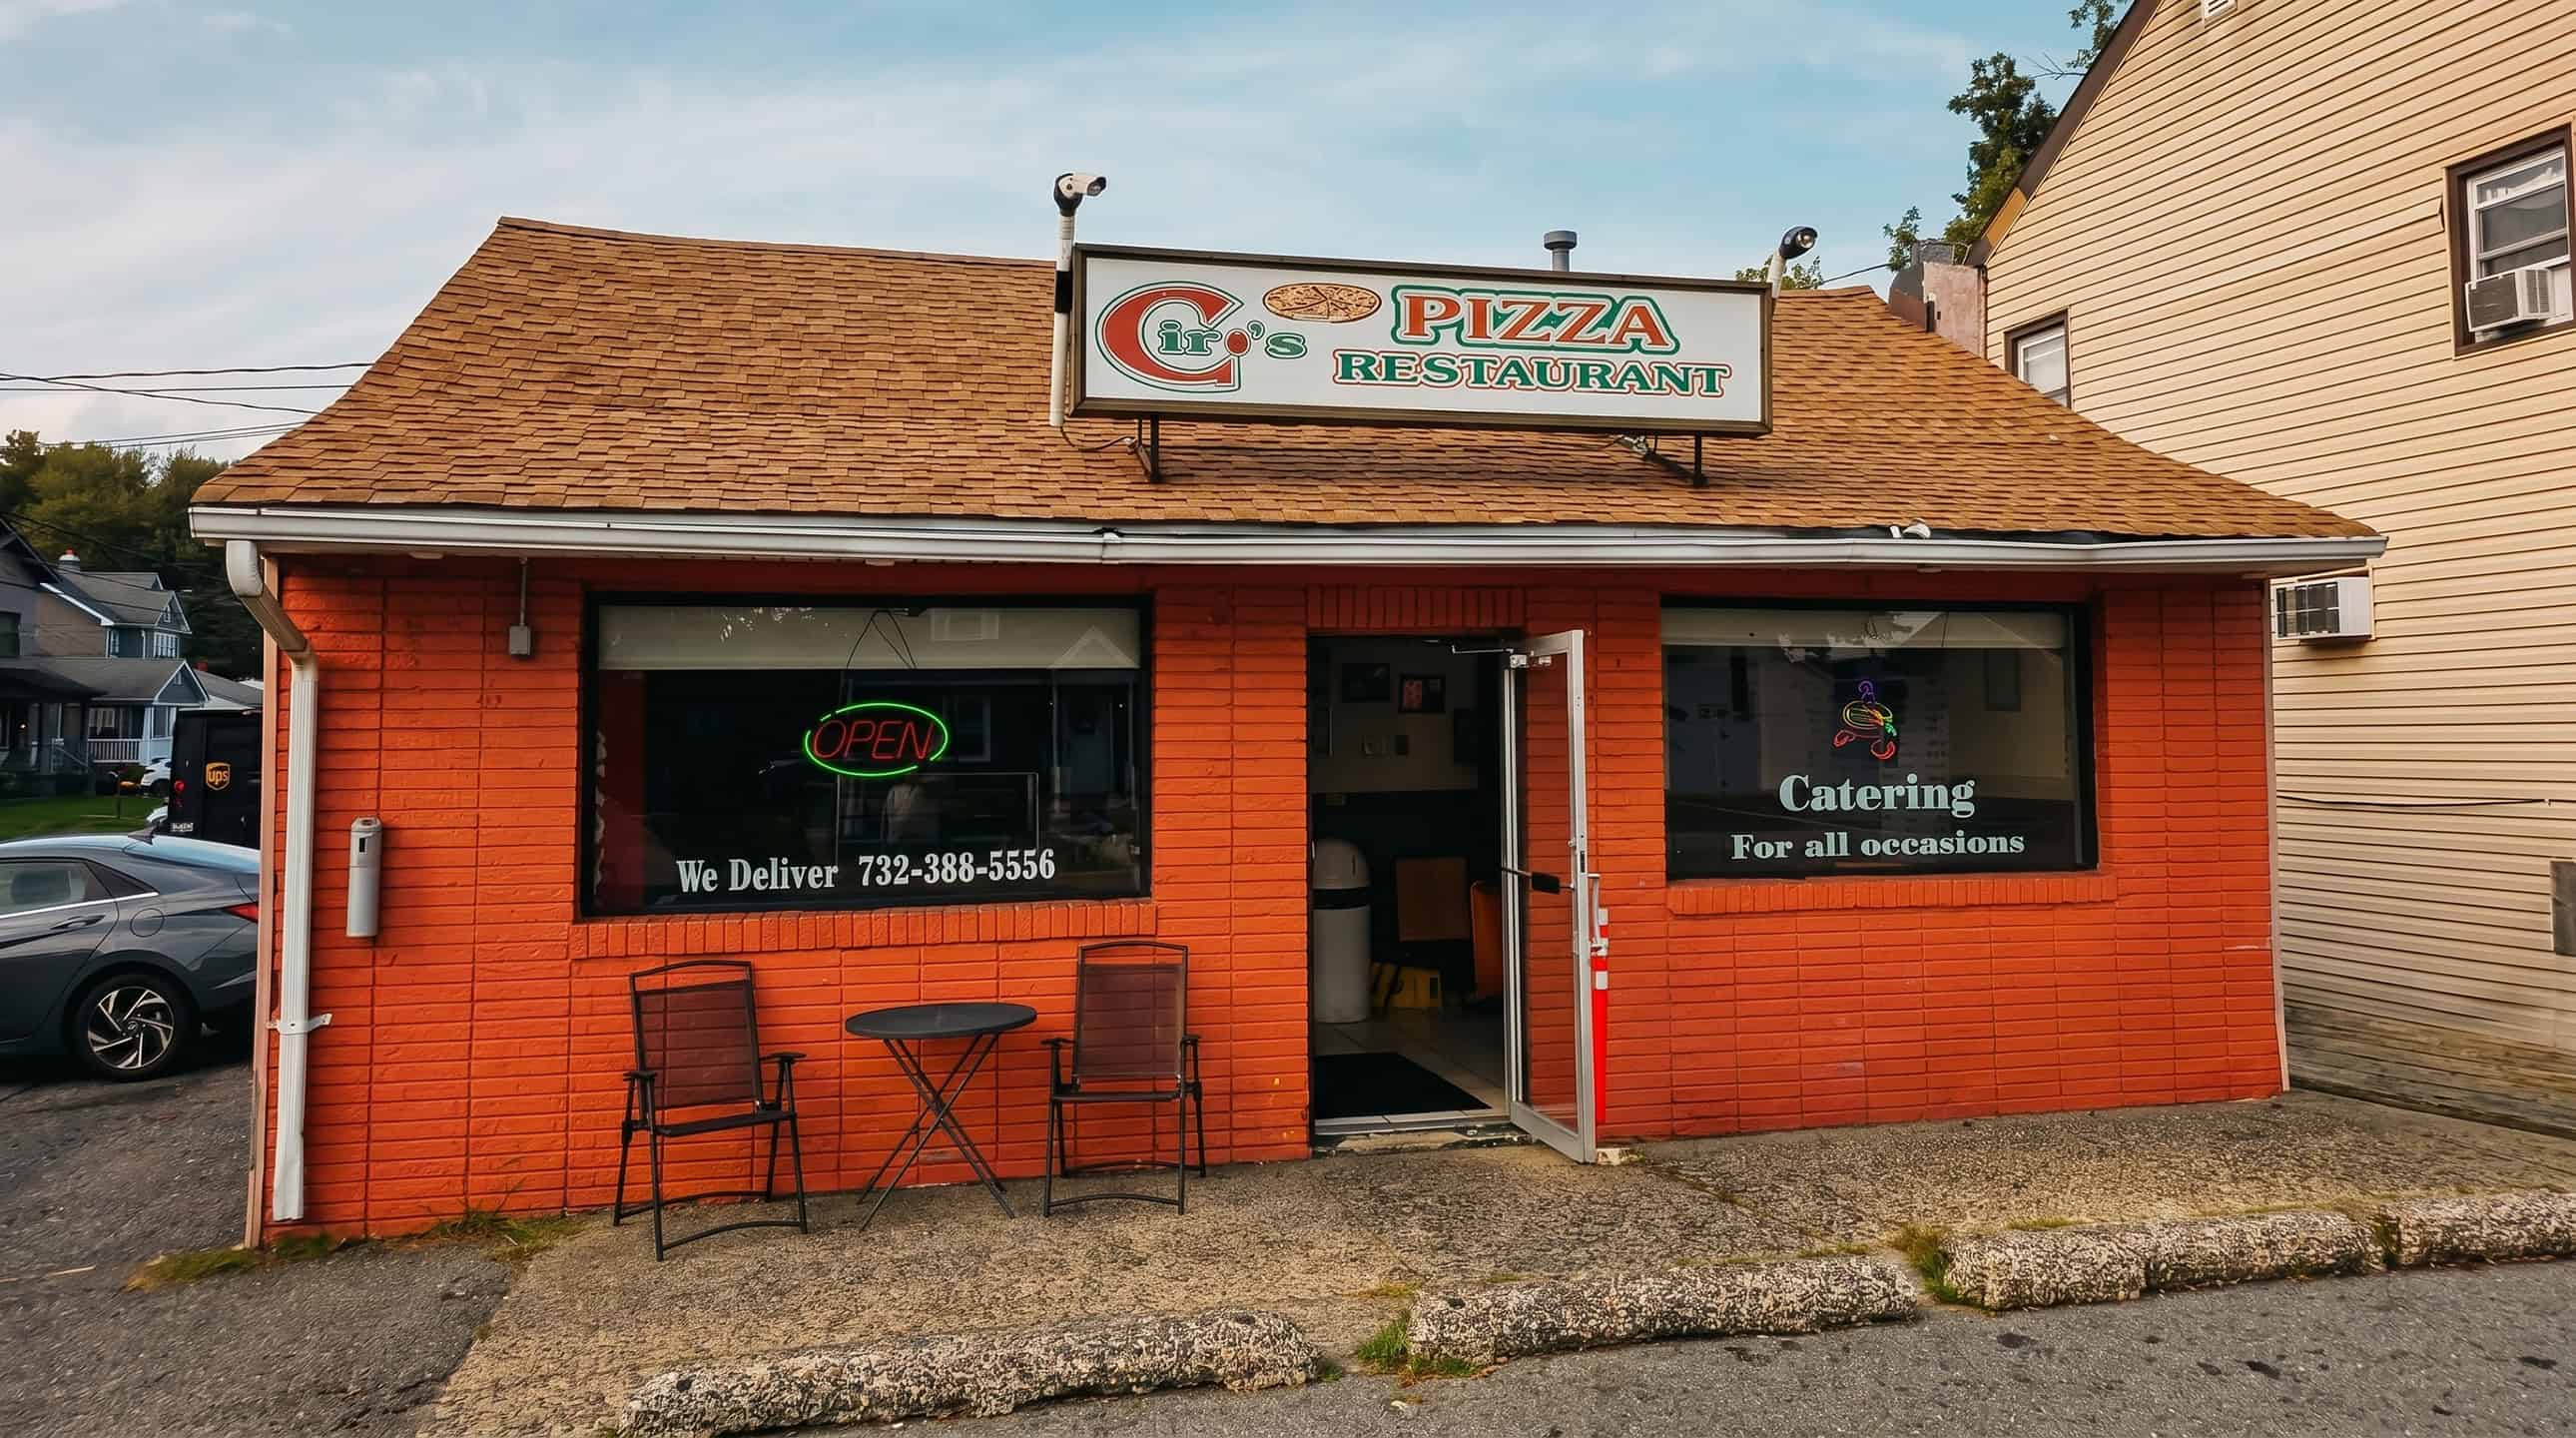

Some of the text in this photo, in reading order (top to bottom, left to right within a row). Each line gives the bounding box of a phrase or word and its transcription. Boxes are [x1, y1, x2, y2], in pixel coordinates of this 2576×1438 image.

[1096, 282, 1307, 393] Ciro's
[1398, 290, 1674, 351] PIZZA
[1337, 351, 1728, 395] RESTAURANT
[814, 719, 935, 759] OPEN
[208, 769, 229, 785] ups
[1779, 773, 1975, 819] Catering
[1730, 830, 2025, 860] For all occasions
[676, 848, 1055, 893] We Deliver 732-388-5556
